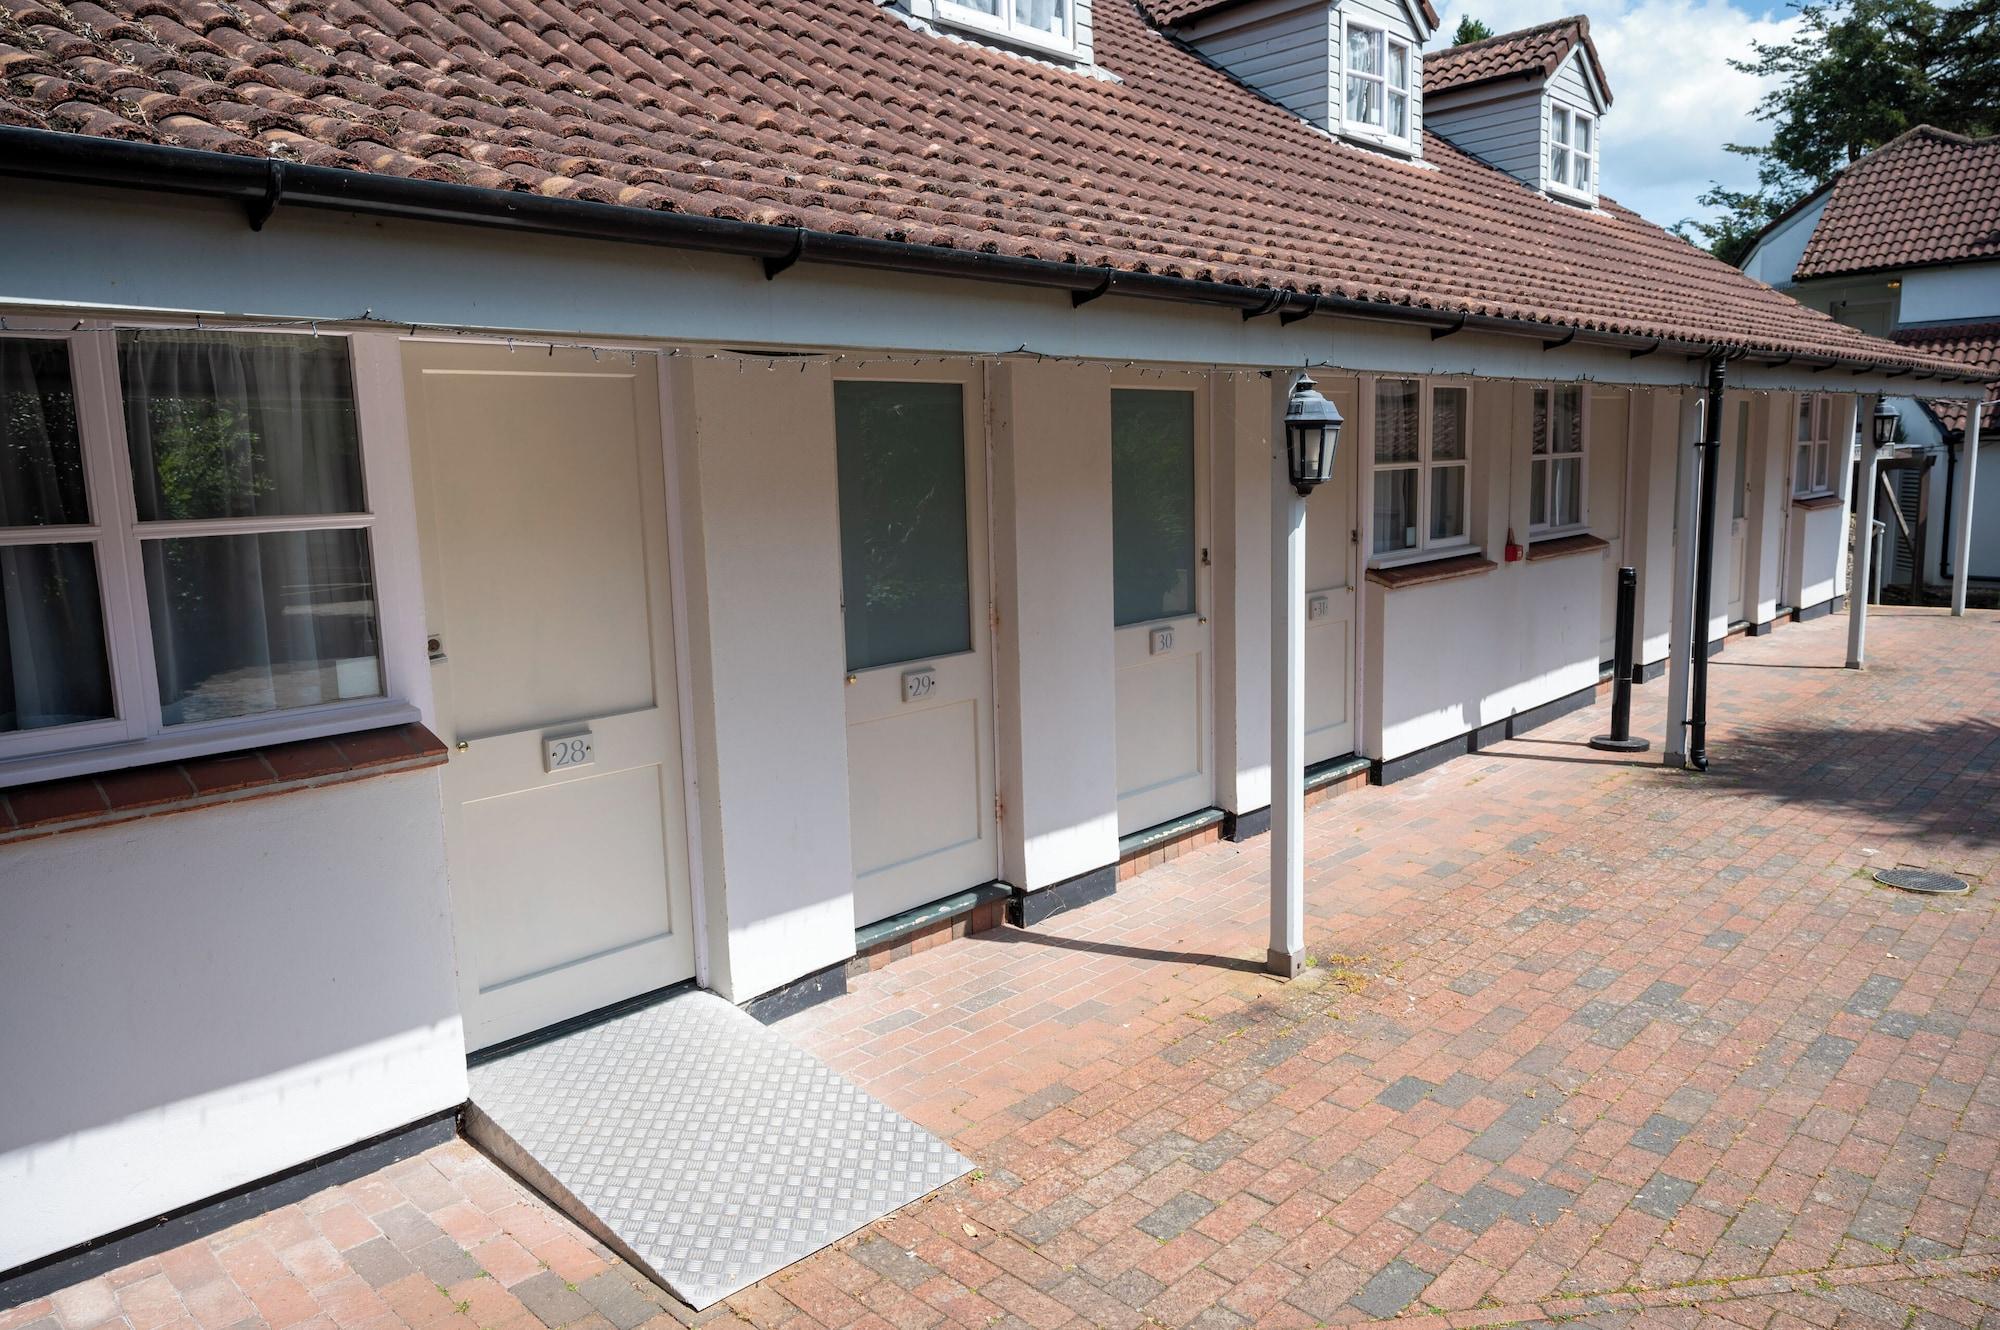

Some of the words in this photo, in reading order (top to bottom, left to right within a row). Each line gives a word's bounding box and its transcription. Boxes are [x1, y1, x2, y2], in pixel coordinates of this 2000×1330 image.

[1160, 632, 1173, 649] 30
[912, 675, 931, 696] 29
[555, 739, 586, 766] 28
